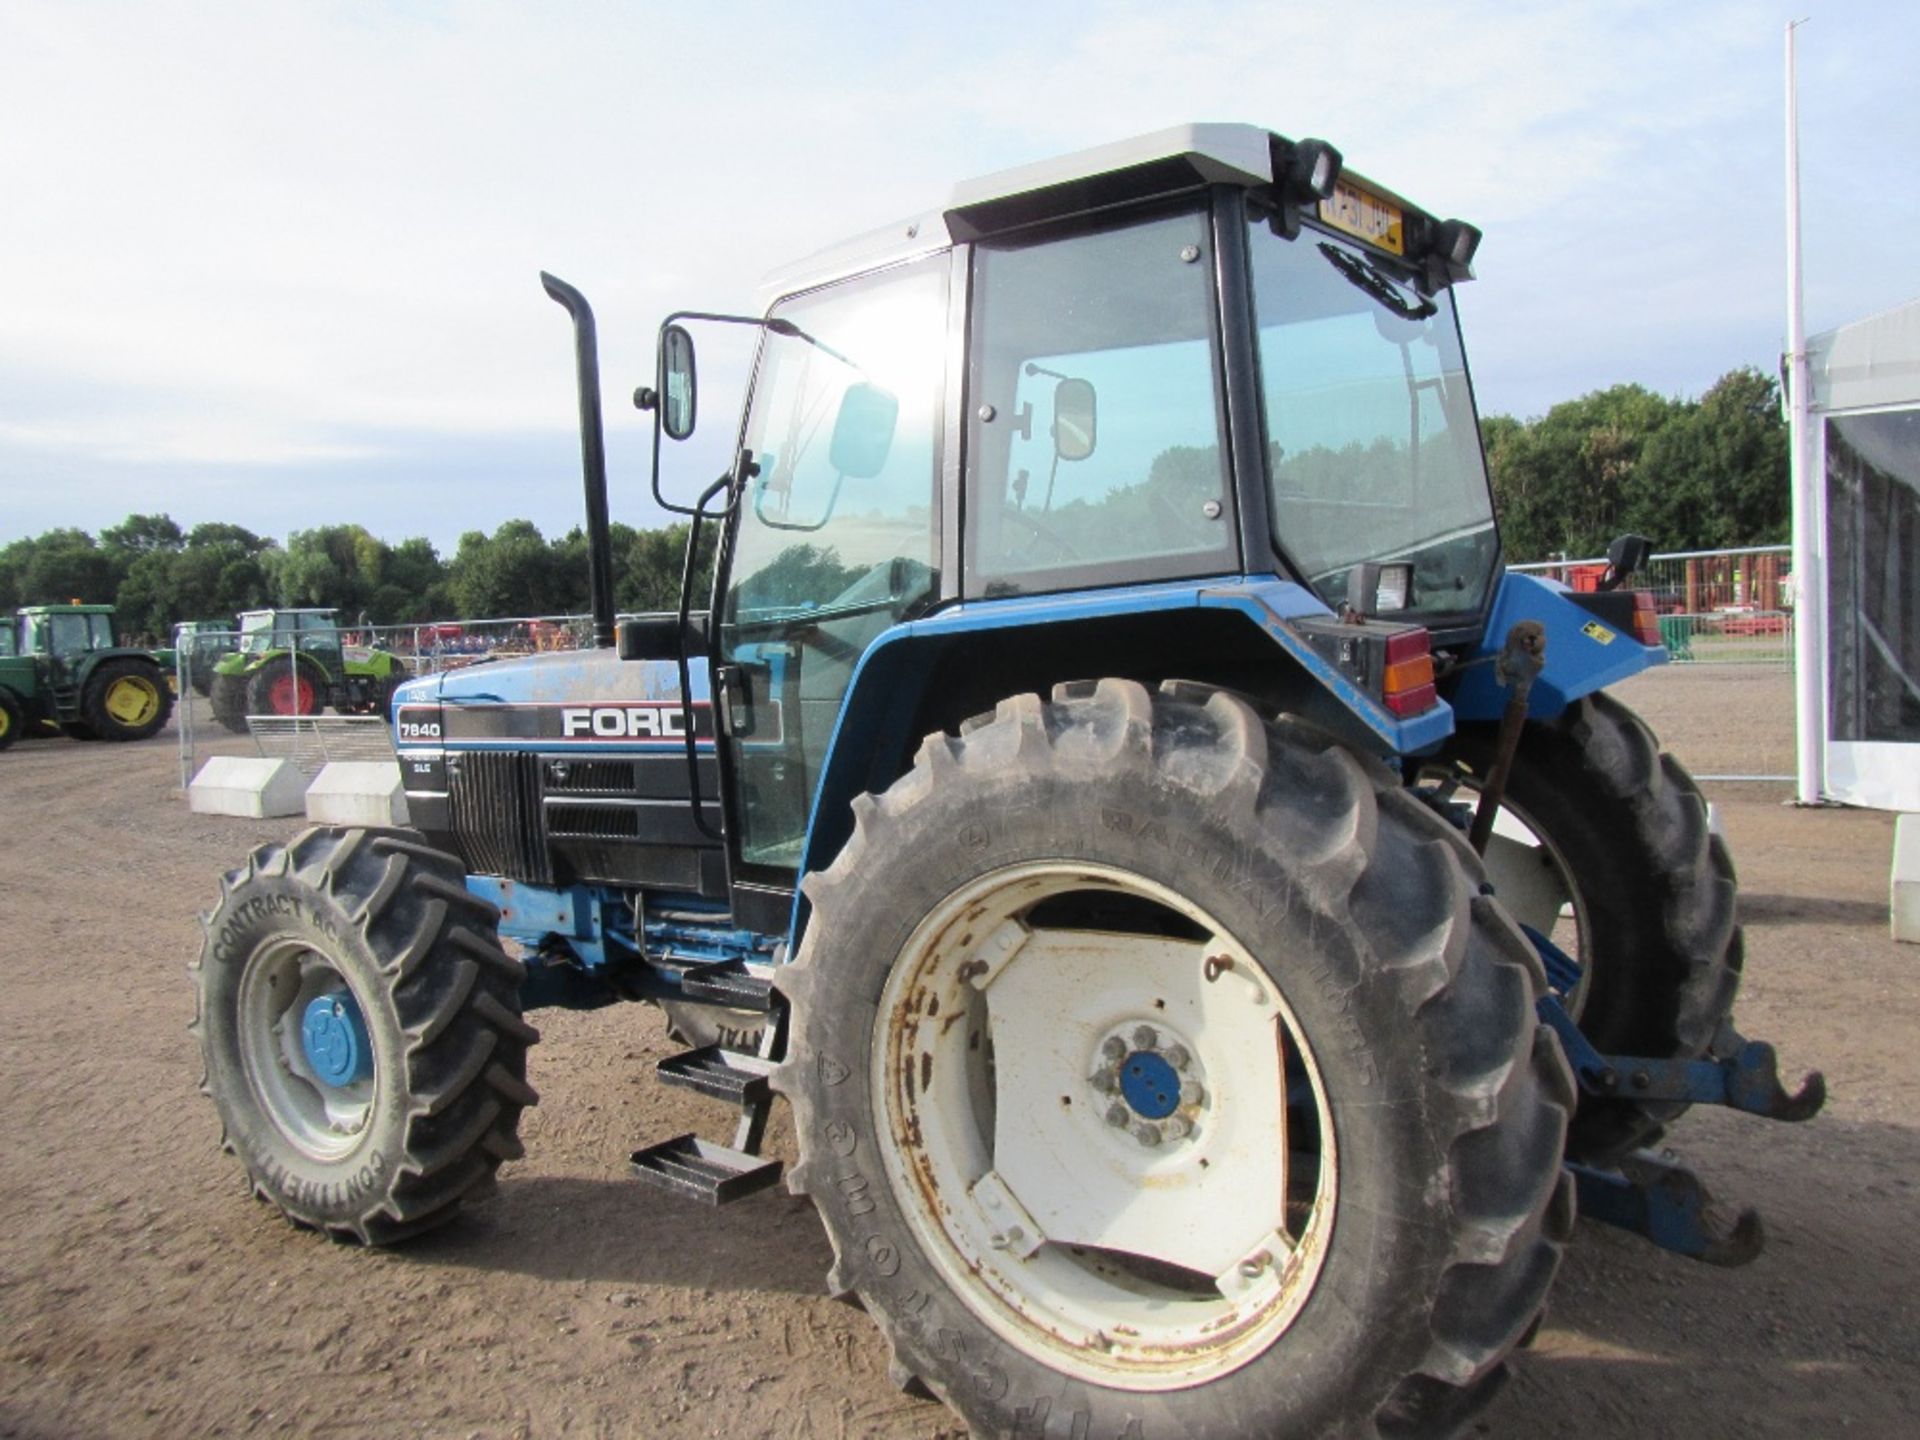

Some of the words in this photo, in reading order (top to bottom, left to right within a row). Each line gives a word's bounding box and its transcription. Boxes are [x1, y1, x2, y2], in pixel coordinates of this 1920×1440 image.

[401, 723, 440, 737] 7840
[562, 707, 696, 737] FORD
[214, 893, 302, 962] CONTRACT
